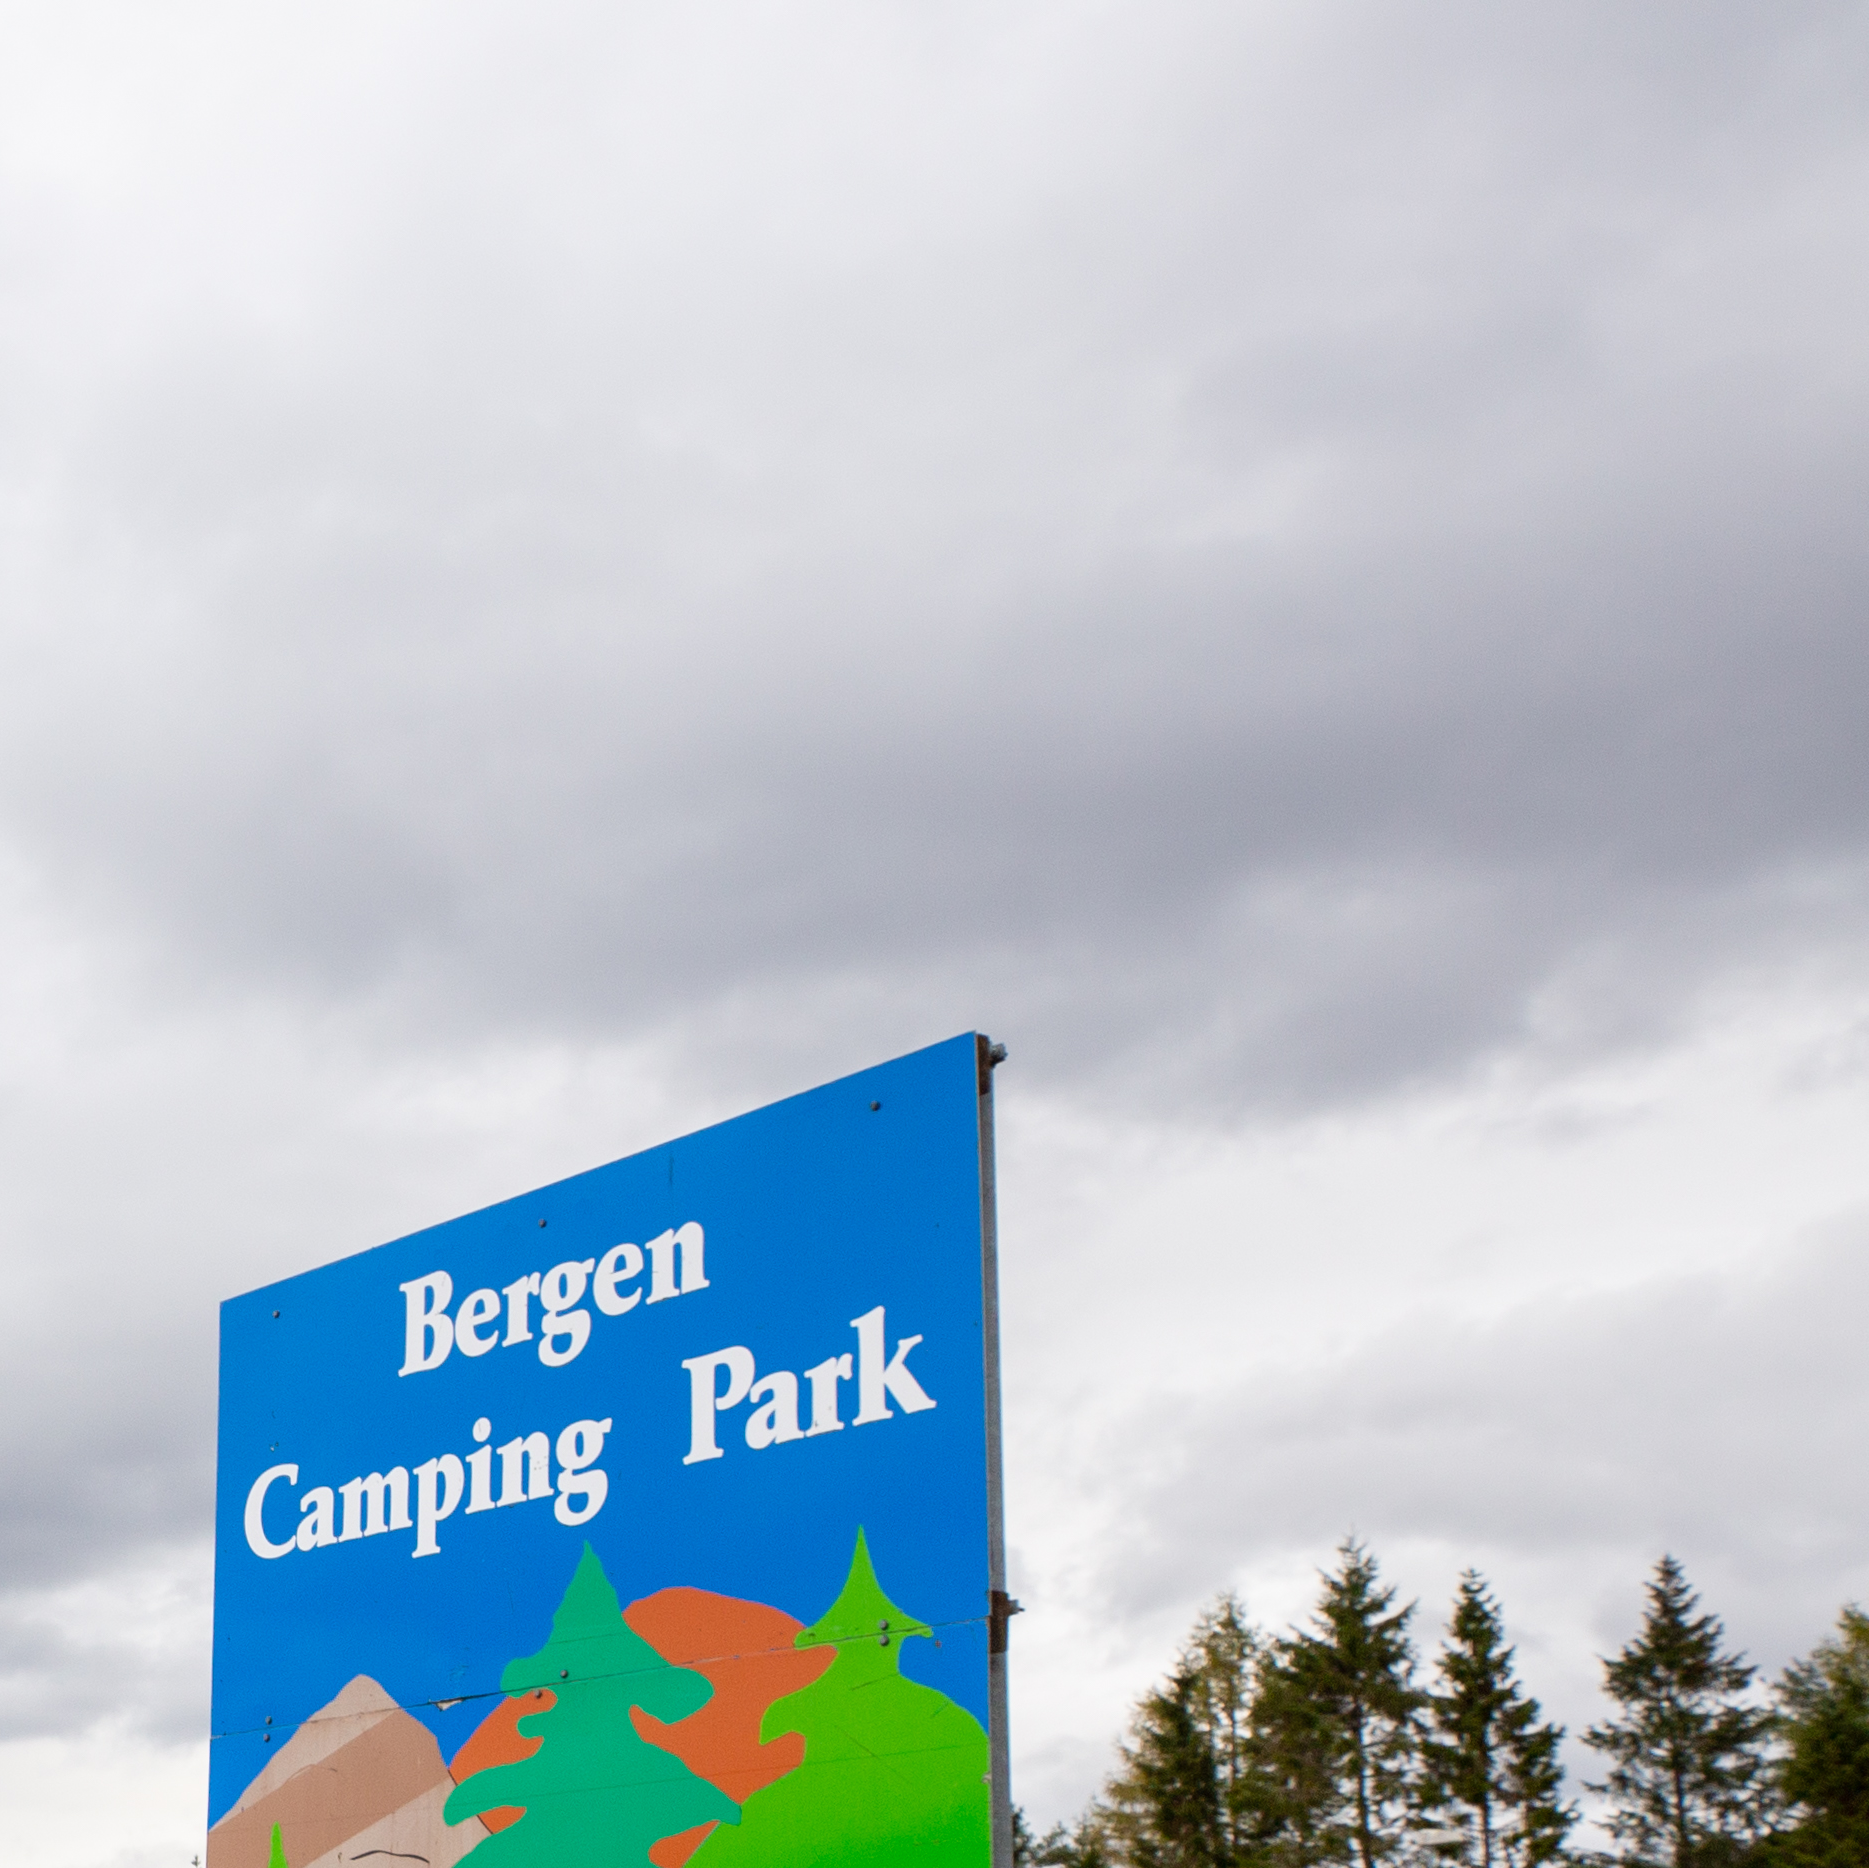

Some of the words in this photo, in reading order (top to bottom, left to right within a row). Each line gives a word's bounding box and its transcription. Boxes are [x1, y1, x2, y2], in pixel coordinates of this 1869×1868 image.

[397, 1221, 710, 1378] Bergen
[244, 1417, 613, 1560] Camping
[681, 1305, 937, 1466] Park
